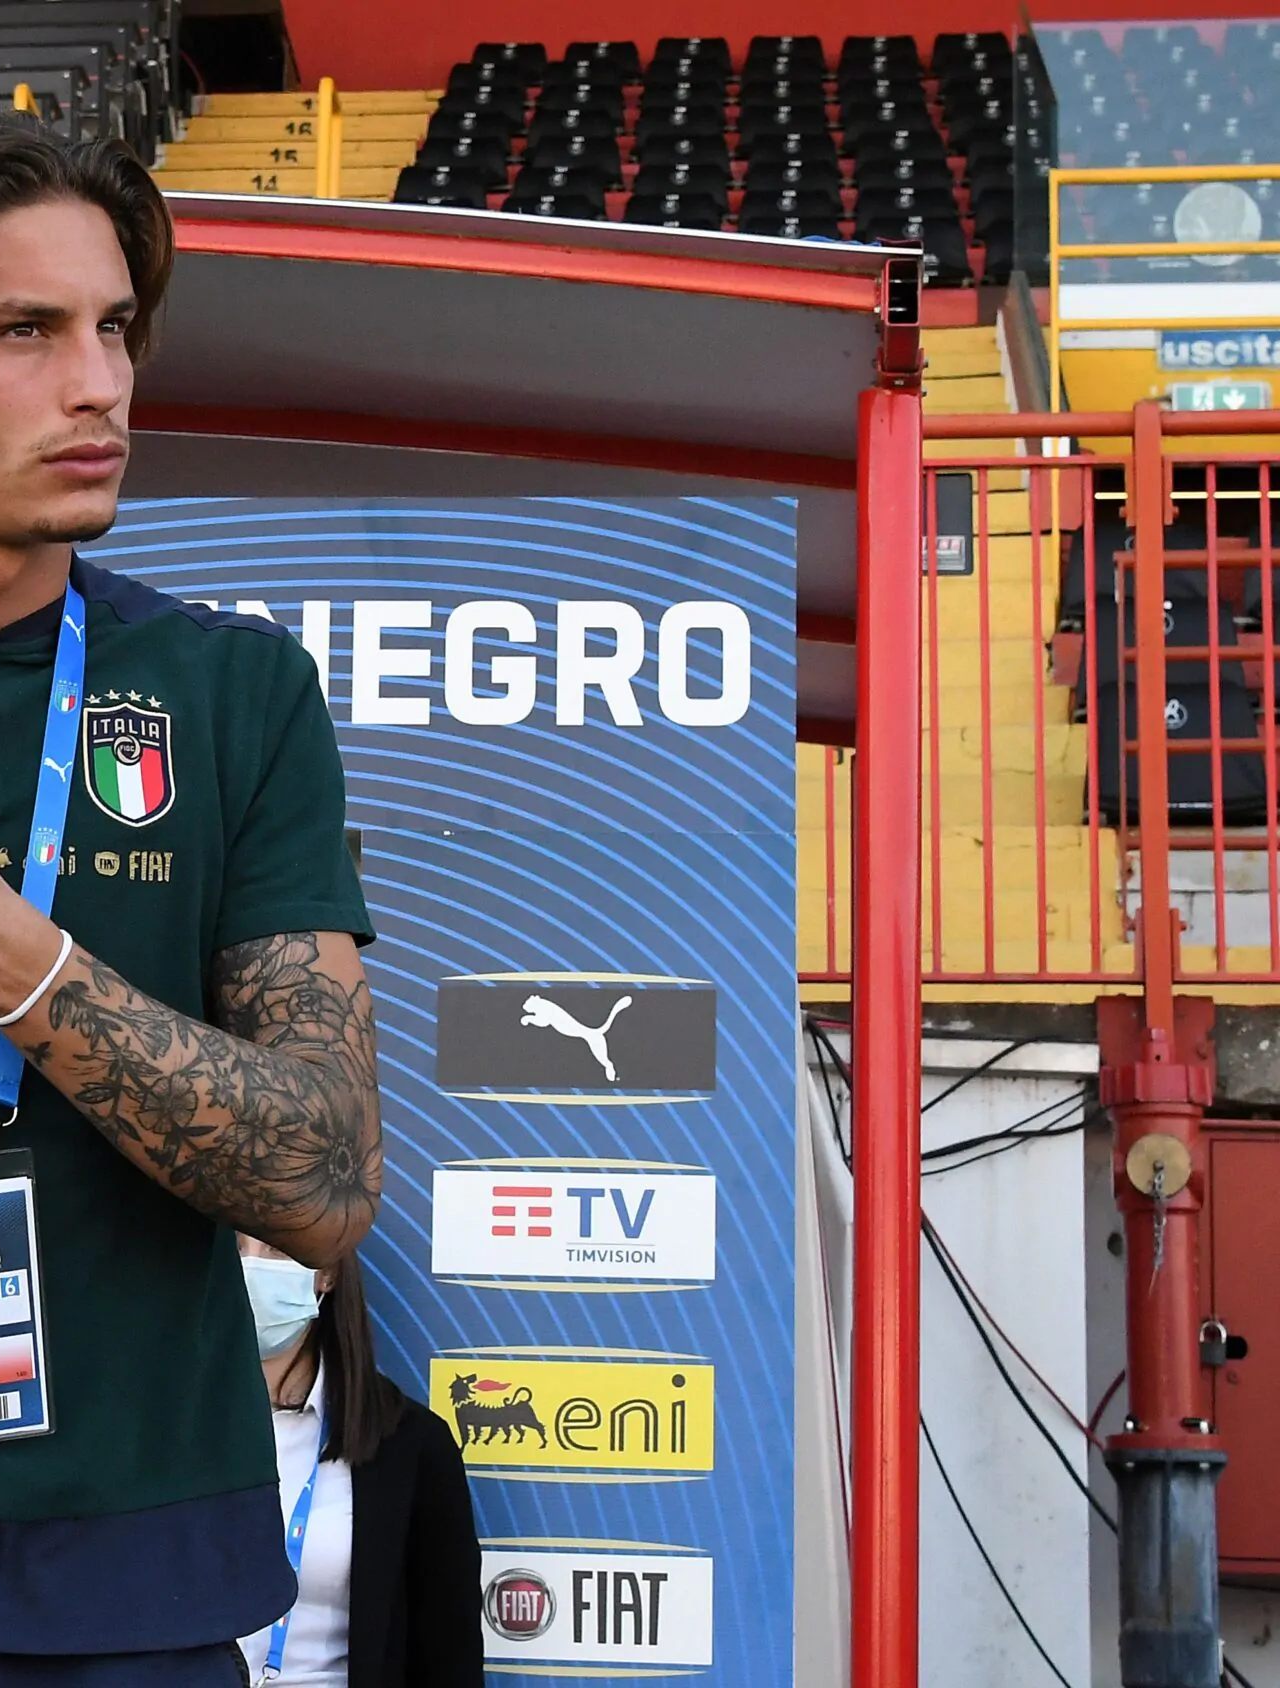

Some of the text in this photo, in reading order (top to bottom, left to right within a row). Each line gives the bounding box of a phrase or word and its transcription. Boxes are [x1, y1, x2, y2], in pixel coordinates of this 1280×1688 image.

[183, 600, 751, 726] EGRO
[93, 718, 160, 739] ITALIA
[129, 851, 173, 882] FIAT
[567, 1188, 655, 1239] TV
[566, 1249, 656, 1264] TIMVISION
[5, 1277, 16, 1296] 6
[554, 1374, 686, 1454] eni
[501, 1570, 668, 1646] FIAT FIAT
